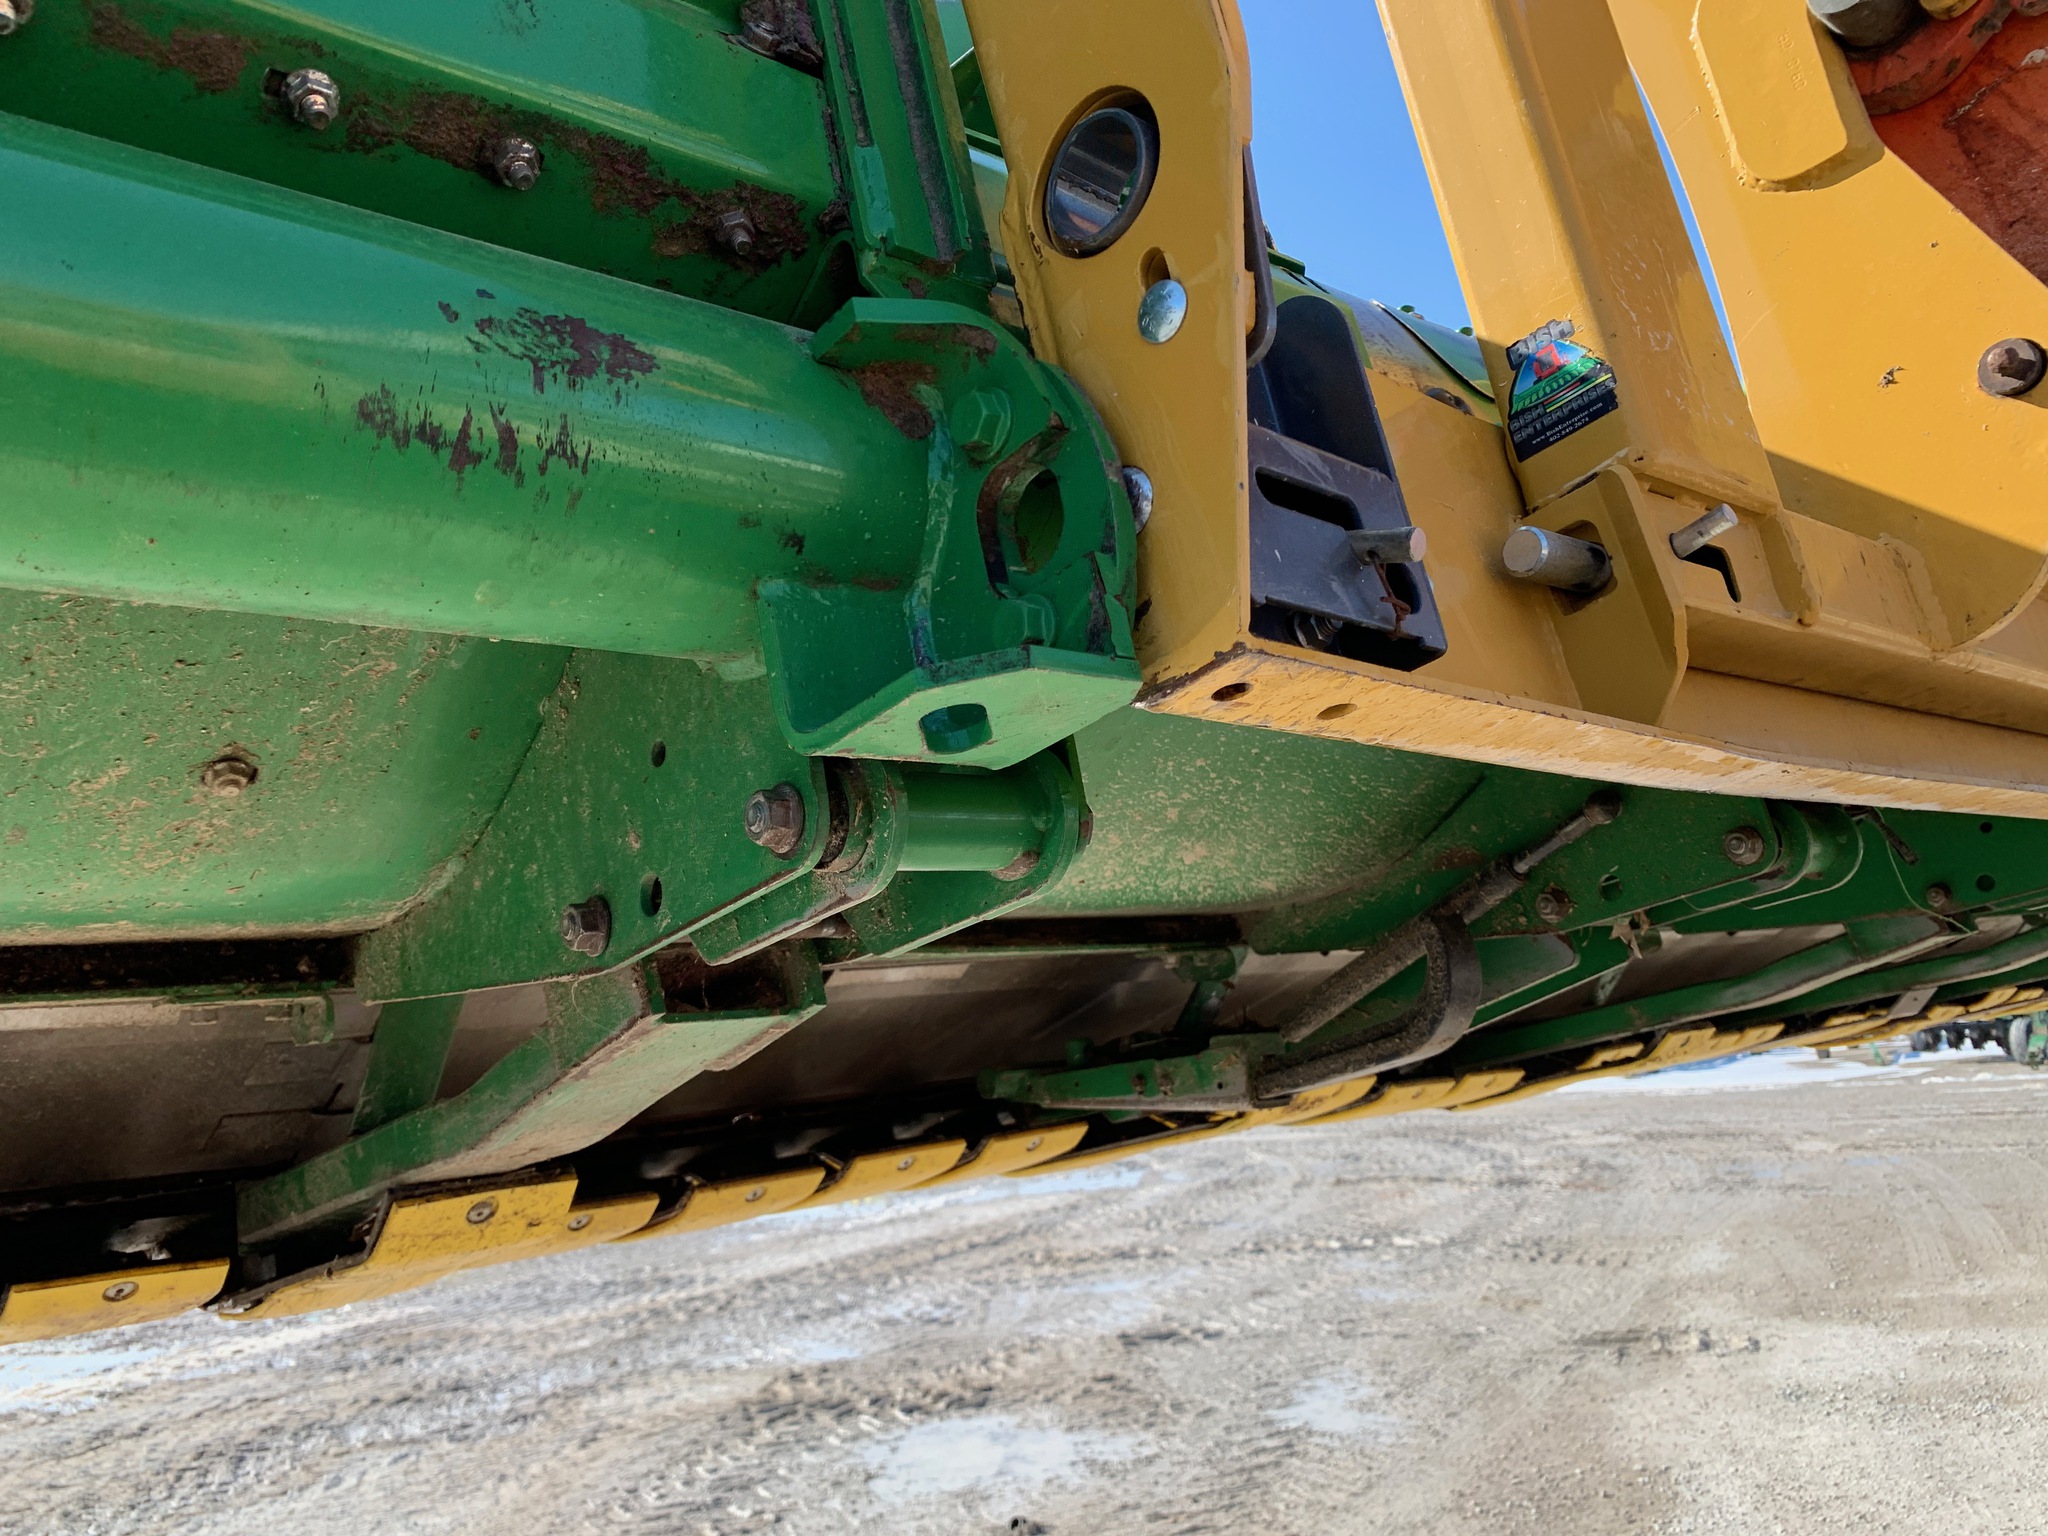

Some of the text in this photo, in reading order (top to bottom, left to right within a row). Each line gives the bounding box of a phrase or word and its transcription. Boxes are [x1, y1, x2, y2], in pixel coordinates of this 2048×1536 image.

[1508, 319, 1574, 366] BISH
[1509, 403, 1547, 431] BISH
[1512, 378, 1617, 444] ENTERPRISES
